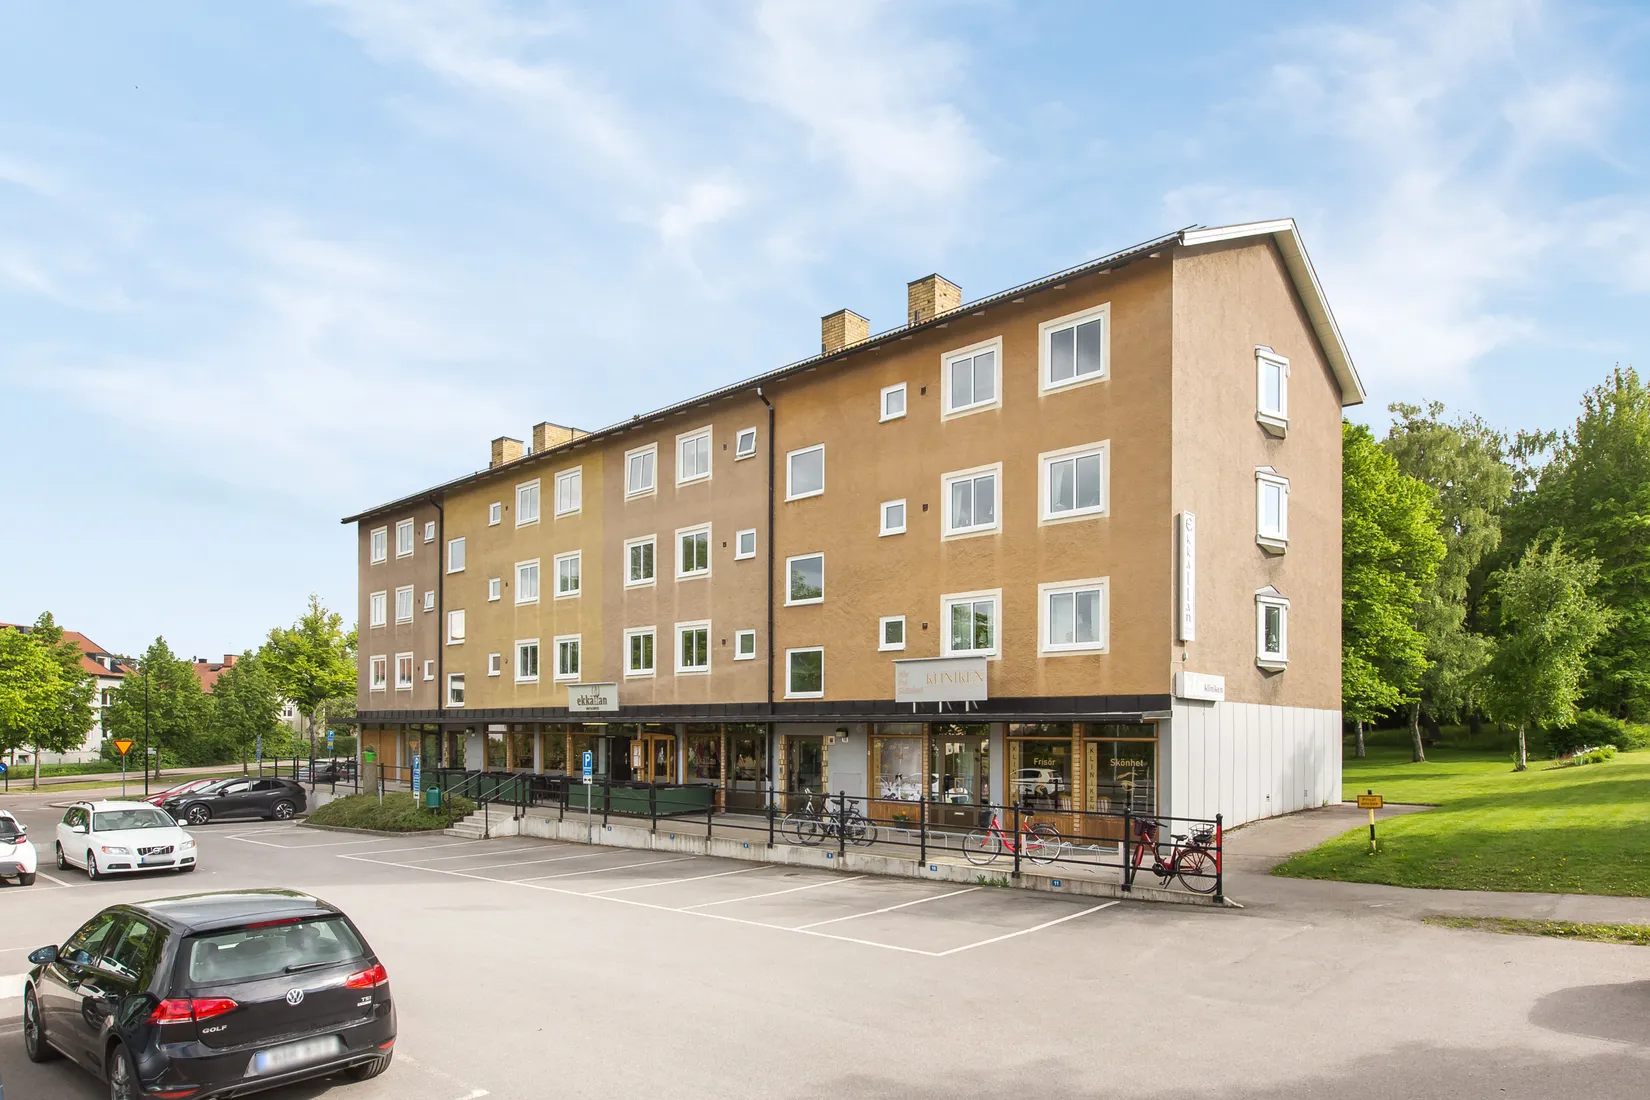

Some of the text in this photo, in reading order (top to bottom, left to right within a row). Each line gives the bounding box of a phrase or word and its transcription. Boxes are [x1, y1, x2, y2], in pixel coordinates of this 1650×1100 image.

[584, 753, 591, 767] P
[1033, 757, 1056, 766] Frisör
[1110, 758, 1144, 767] Skönhet
[202, 1024, 228, 1034] GOLF
